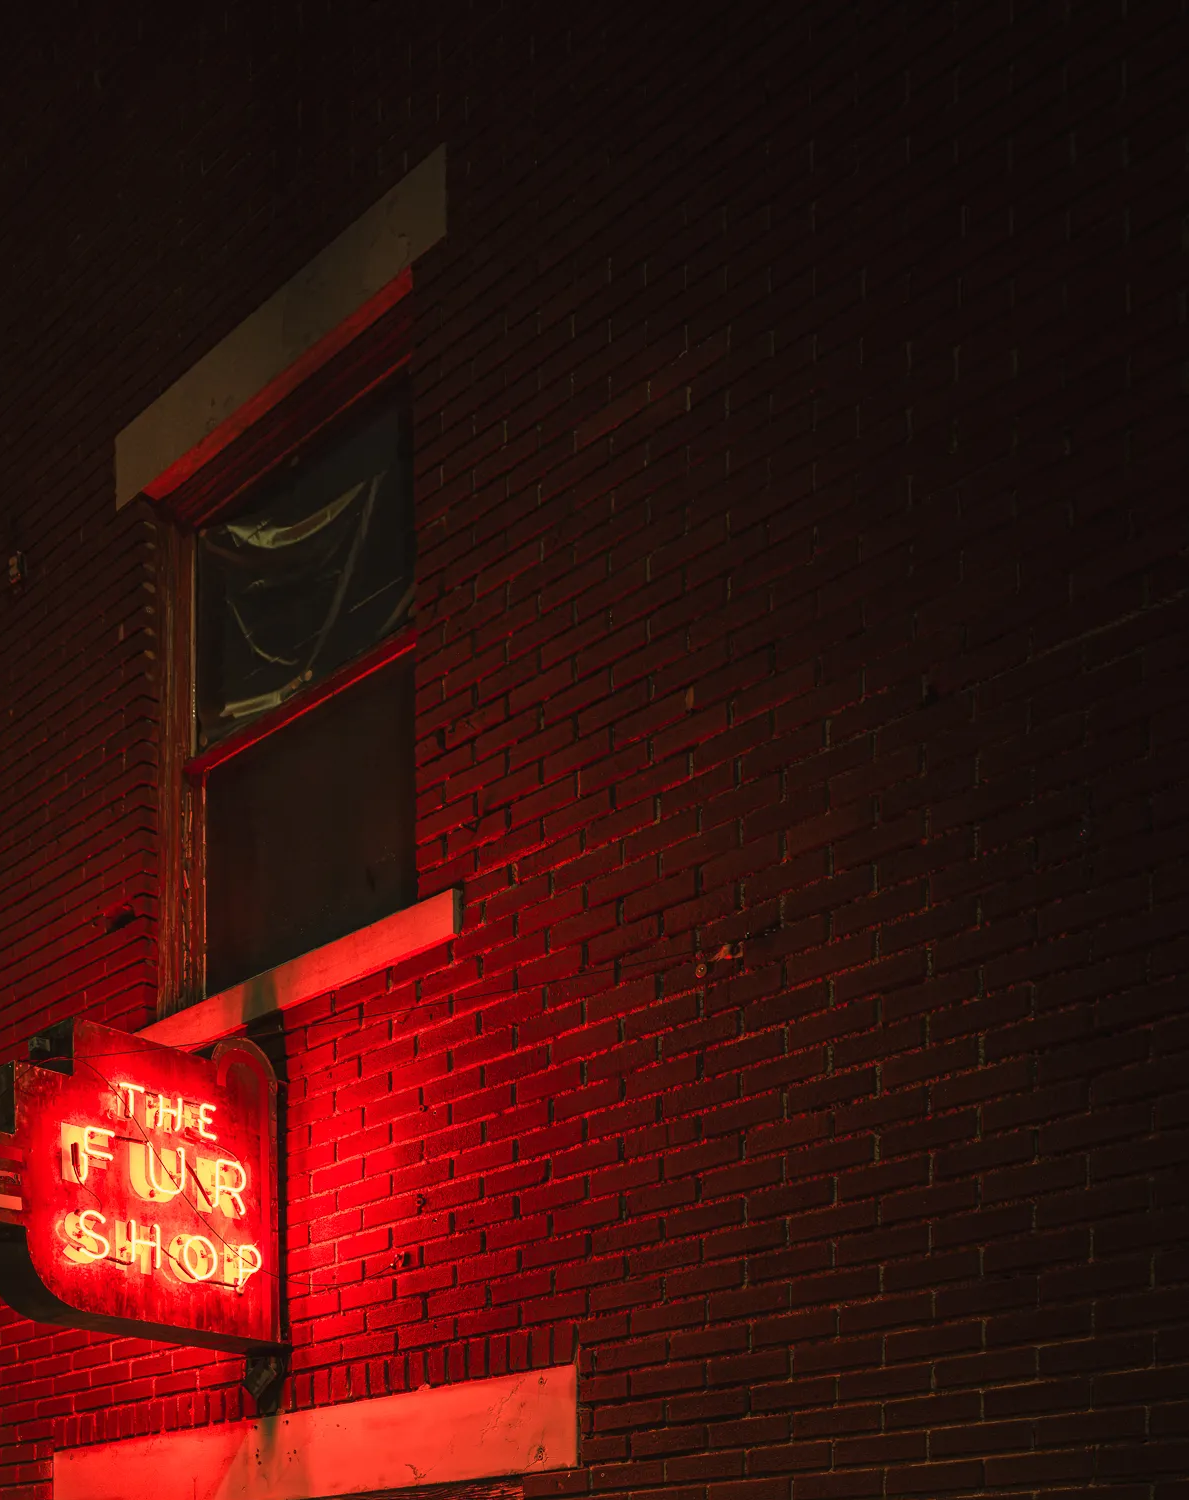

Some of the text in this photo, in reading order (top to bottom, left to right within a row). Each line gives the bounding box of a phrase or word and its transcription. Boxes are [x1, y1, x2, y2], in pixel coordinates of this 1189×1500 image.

[110, 1082, 218, 1142] THE
[61, 1121, 249, 1219] FUR
[60, 1209, 263, 1293] SHOP
